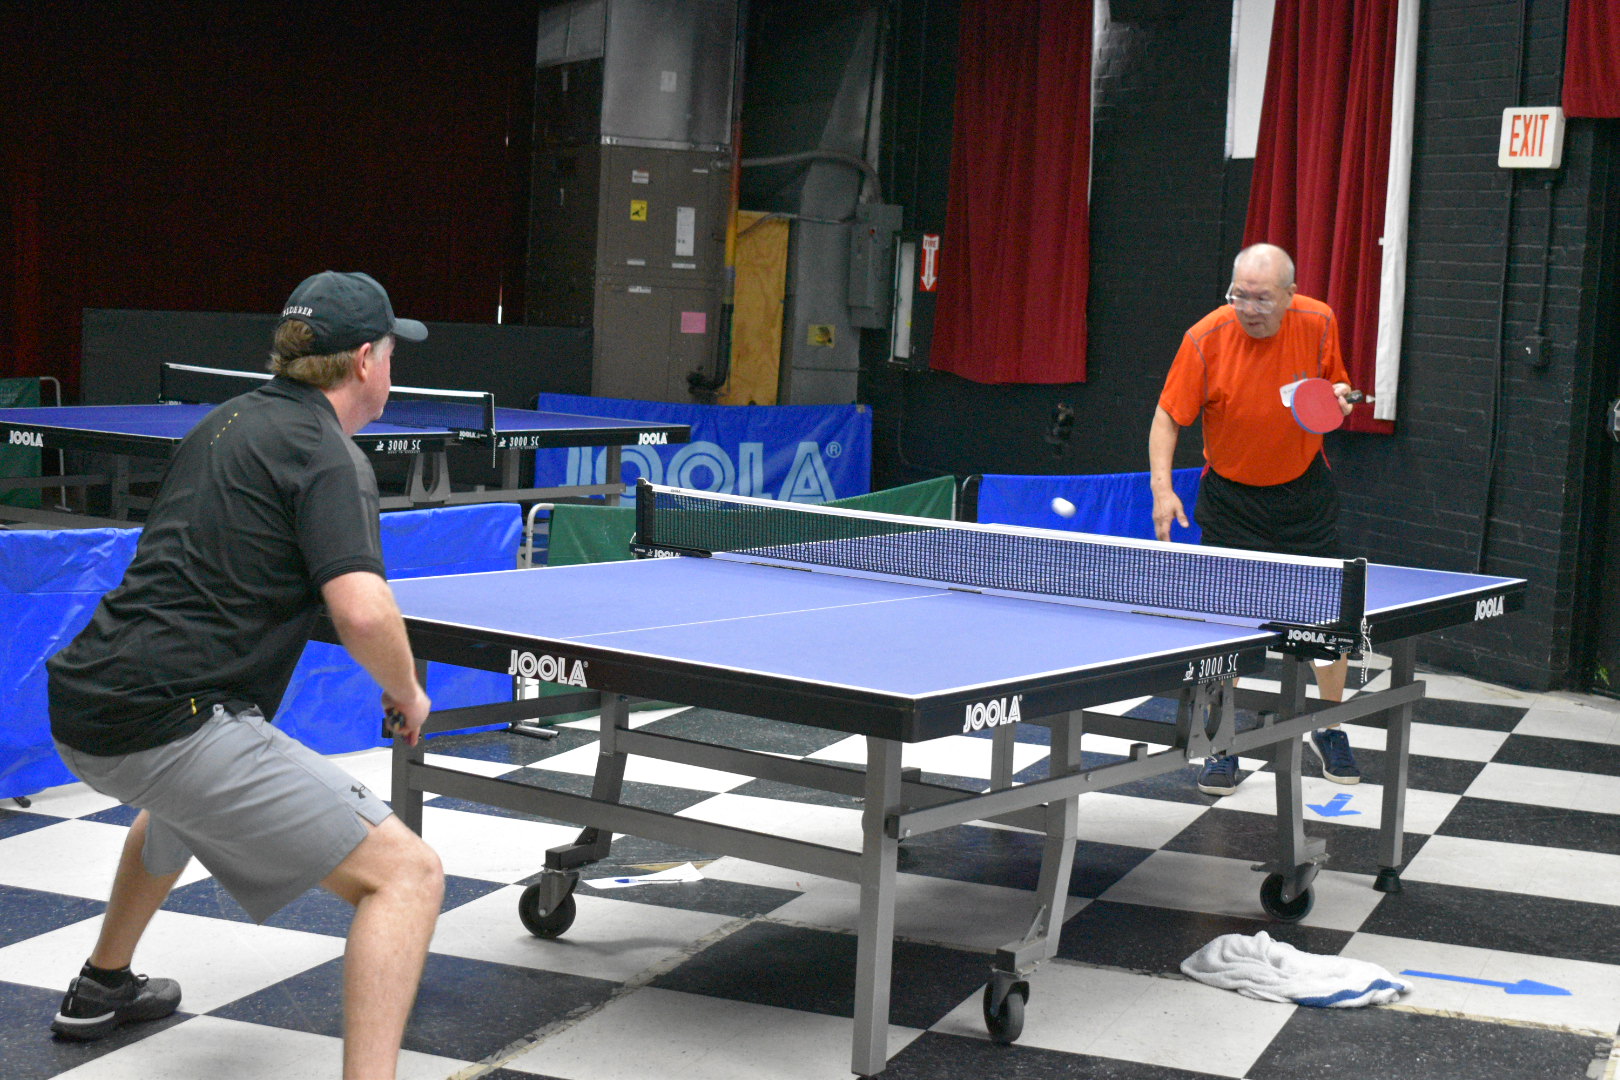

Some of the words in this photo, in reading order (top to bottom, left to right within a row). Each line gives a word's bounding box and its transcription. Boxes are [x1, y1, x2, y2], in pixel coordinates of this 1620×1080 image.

[1509, 114, 1549, 157] EXIT
[9, 430, 44, 448] JOOLA
[388, 440, 408, 451] 3000
[411, 440, 421, 450] SC
[509, 436, 528, 447] 3000
[530, 436, 540, 446] SC
[638, 432, 668, 446] JOOLA
[1474, 595, 1505, 622] JOOLA
[1287, 629, 1326, 644] JOOLA
[508, 649, 589, 688] JOOLA
[1198, 656, 1223, 678] 3000
[1226, 652, 1239, 673] SC
[963, 694, 1022, 734] JOOLA
